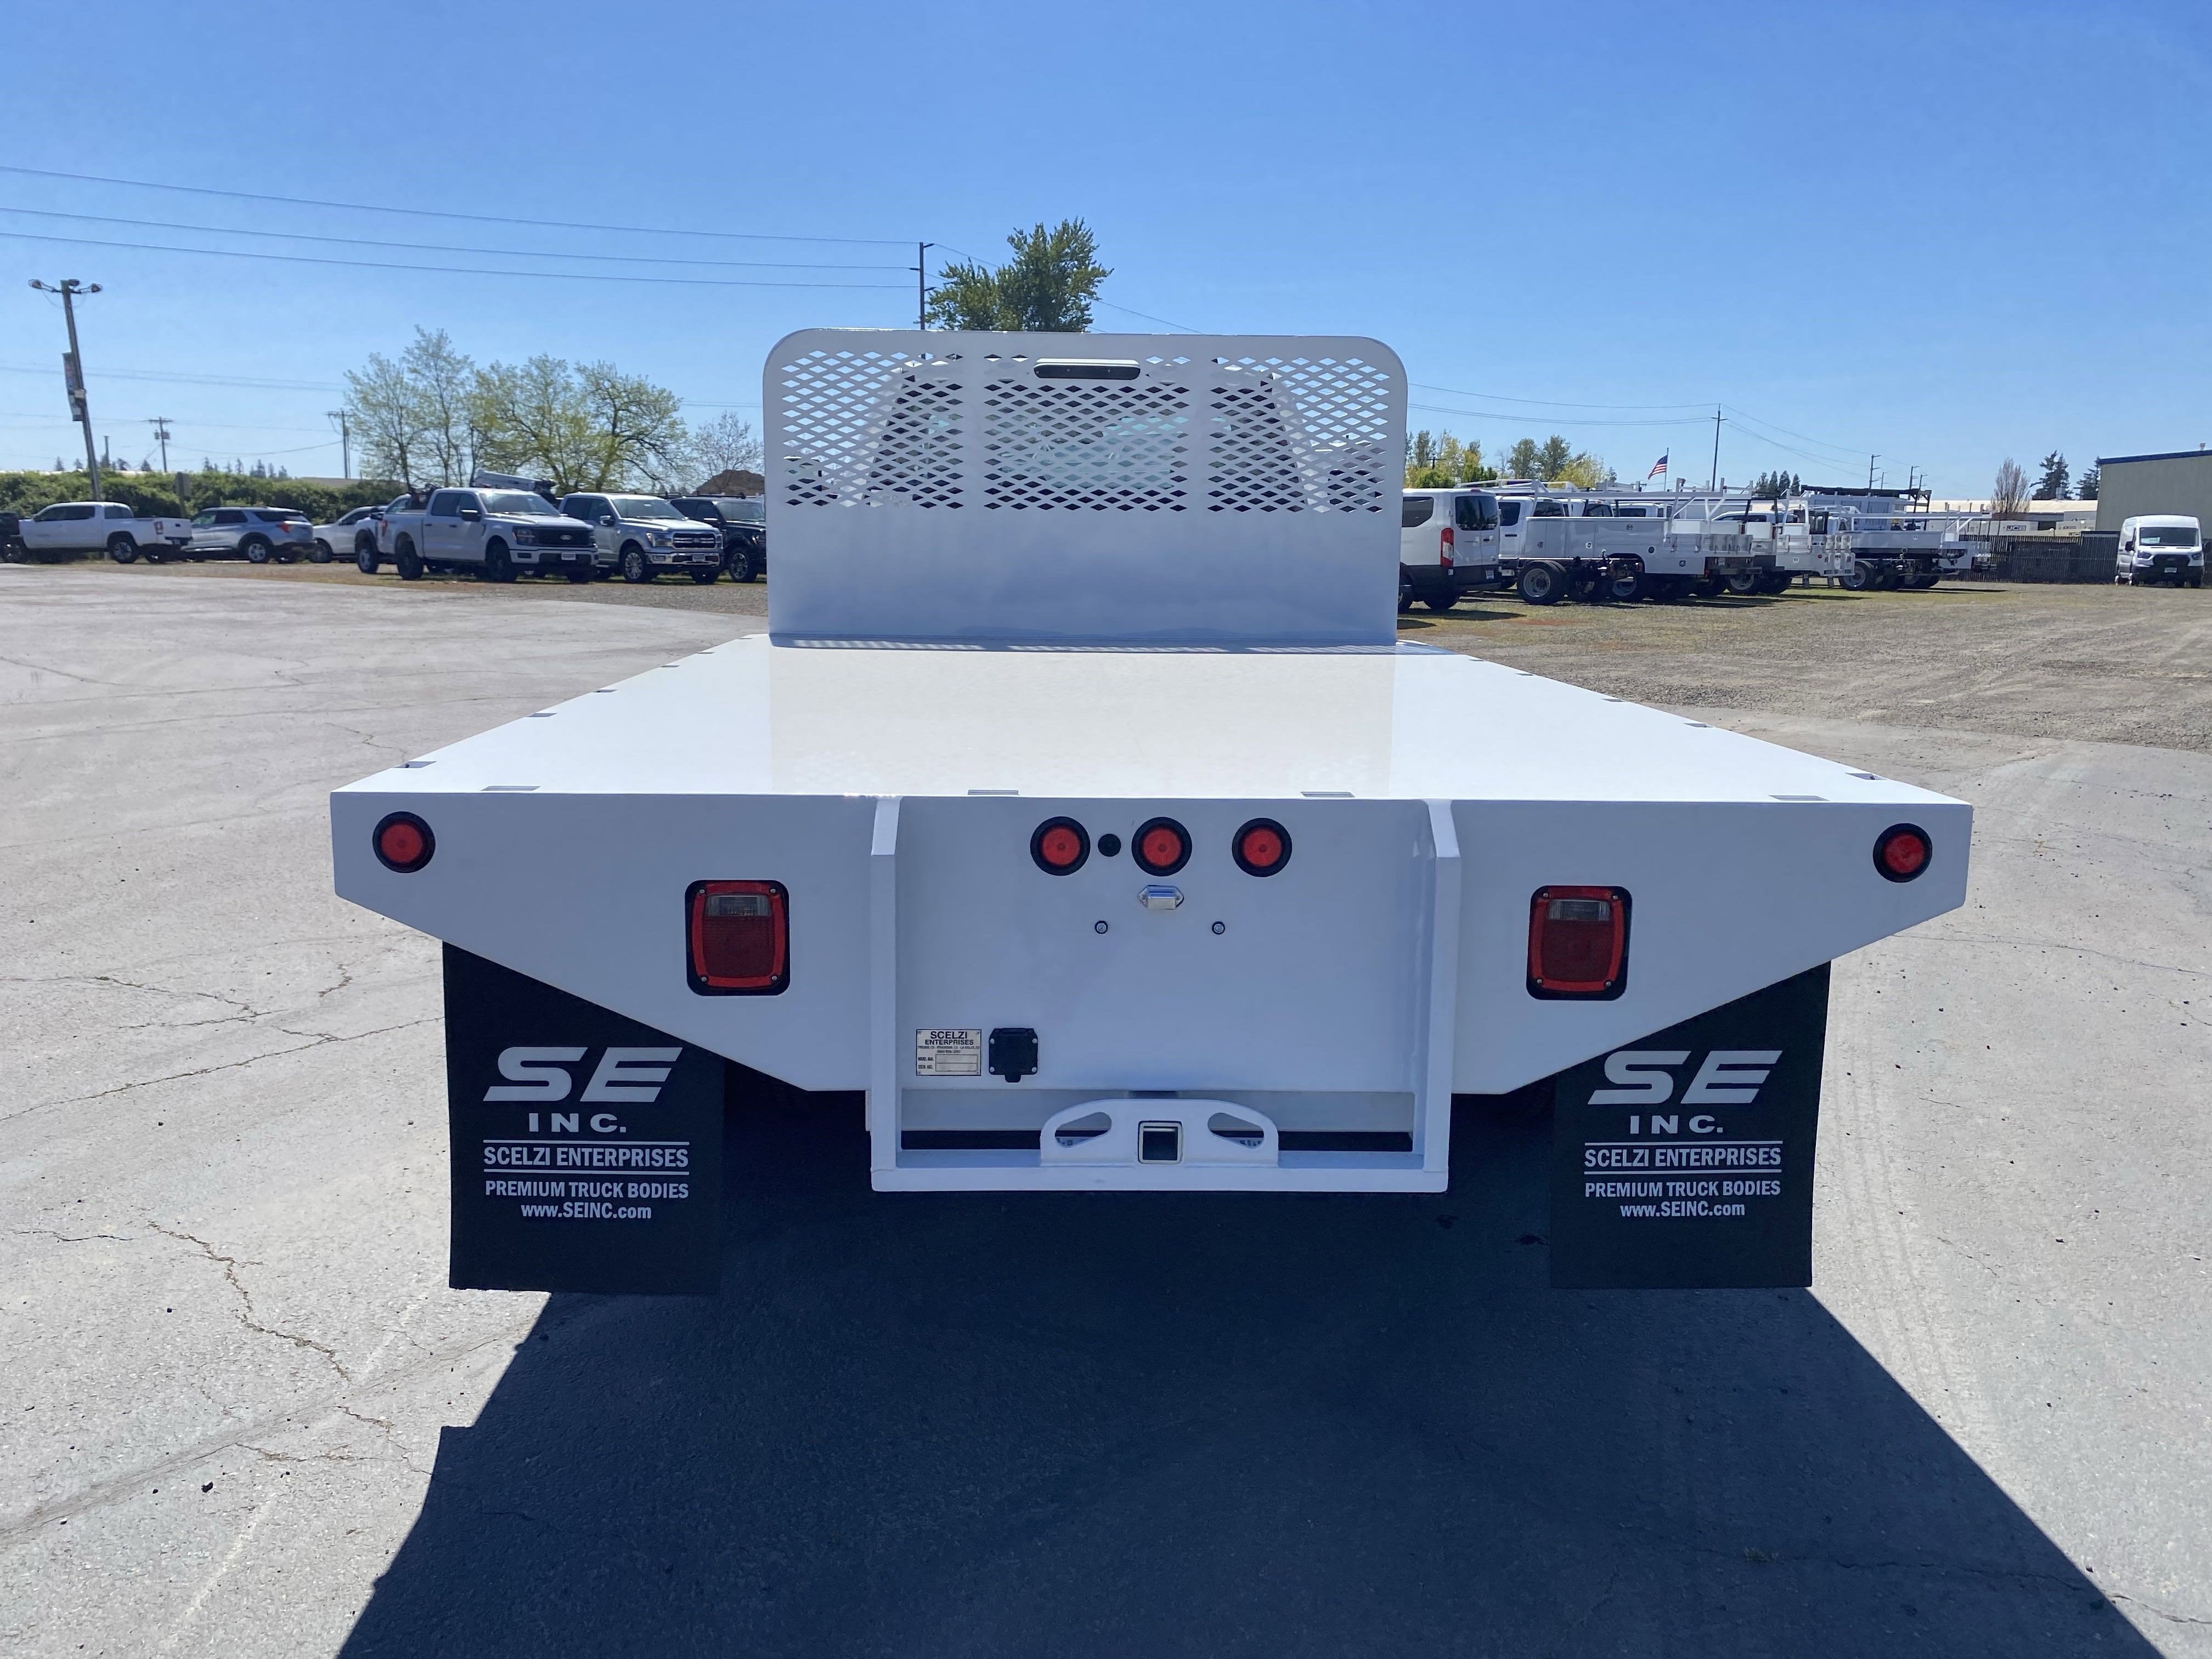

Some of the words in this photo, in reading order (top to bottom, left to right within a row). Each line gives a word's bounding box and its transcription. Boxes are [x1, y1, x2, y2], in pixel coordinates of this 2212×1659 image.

[930, 1031, 967, 1039] SCELZI
[483, 1047, 682, 1102] SE
[1588, 1050, 1782, 1104] SE
[529, 1113, 626, 1132] INC.
[1630, 1115, 1723, 1134] INC.
[484, 1147, 550, 1165] SCELZI
[557, 1148, 688, 1167] ENTERPRISES
[1584, 1149, 1649, 1166] SCELZI
[1656, 1148, 1781, 1166] ENTERPRISES
[486, 1181, 565, 1197] PREMIUM
[569, 1182, 623, 1197] TRUCK
[628, 1183, 688, 1198] BODIES
[1585, 1182, 1662, 1197] PREMIUM
[1666, 1182, 1718, 1196] TRUCK
[1723, 1181, 1780, 1195] BODIES
[521, 1202, 651, 1218] www.SEINC.com
[1620, 1201, 1745, 1216] www.SEINC.com
